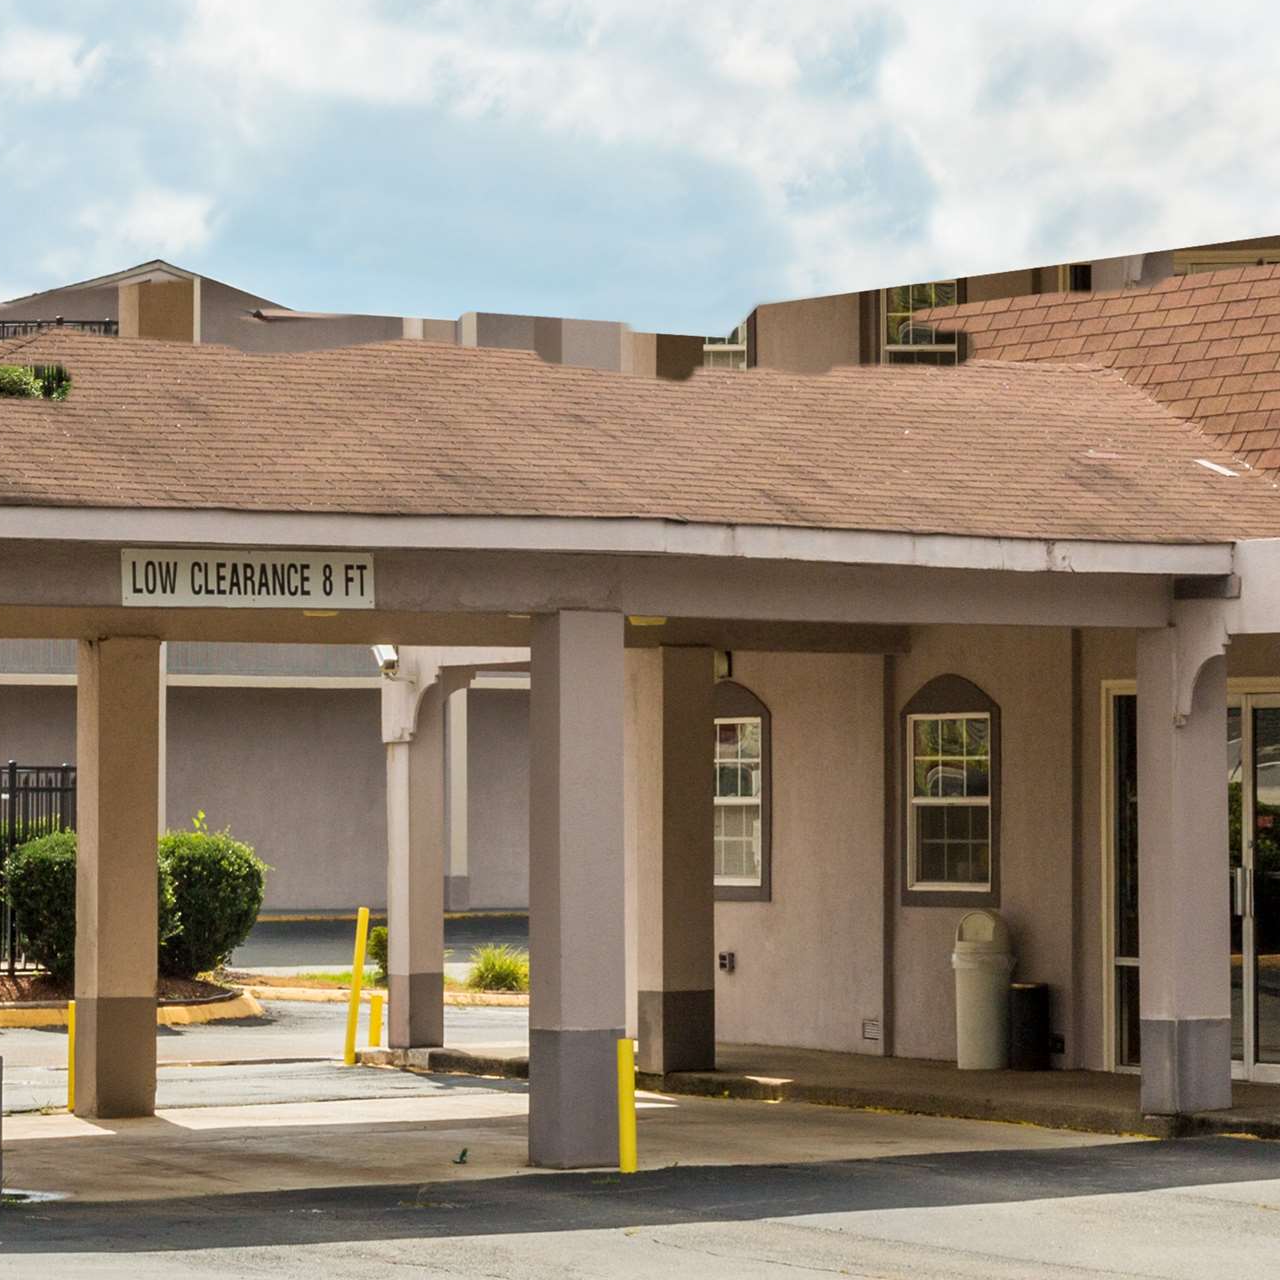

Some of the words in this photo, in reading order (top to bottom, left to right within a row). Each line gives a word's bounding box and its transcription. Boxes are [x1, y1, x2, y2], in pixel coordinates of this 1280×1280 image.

[131, 561, 178, 594] LOW
[190, 562, 311, 596] CLEARANCE
[322, 563, 333, 597] 8
[344, 564, 368, 597] FT
